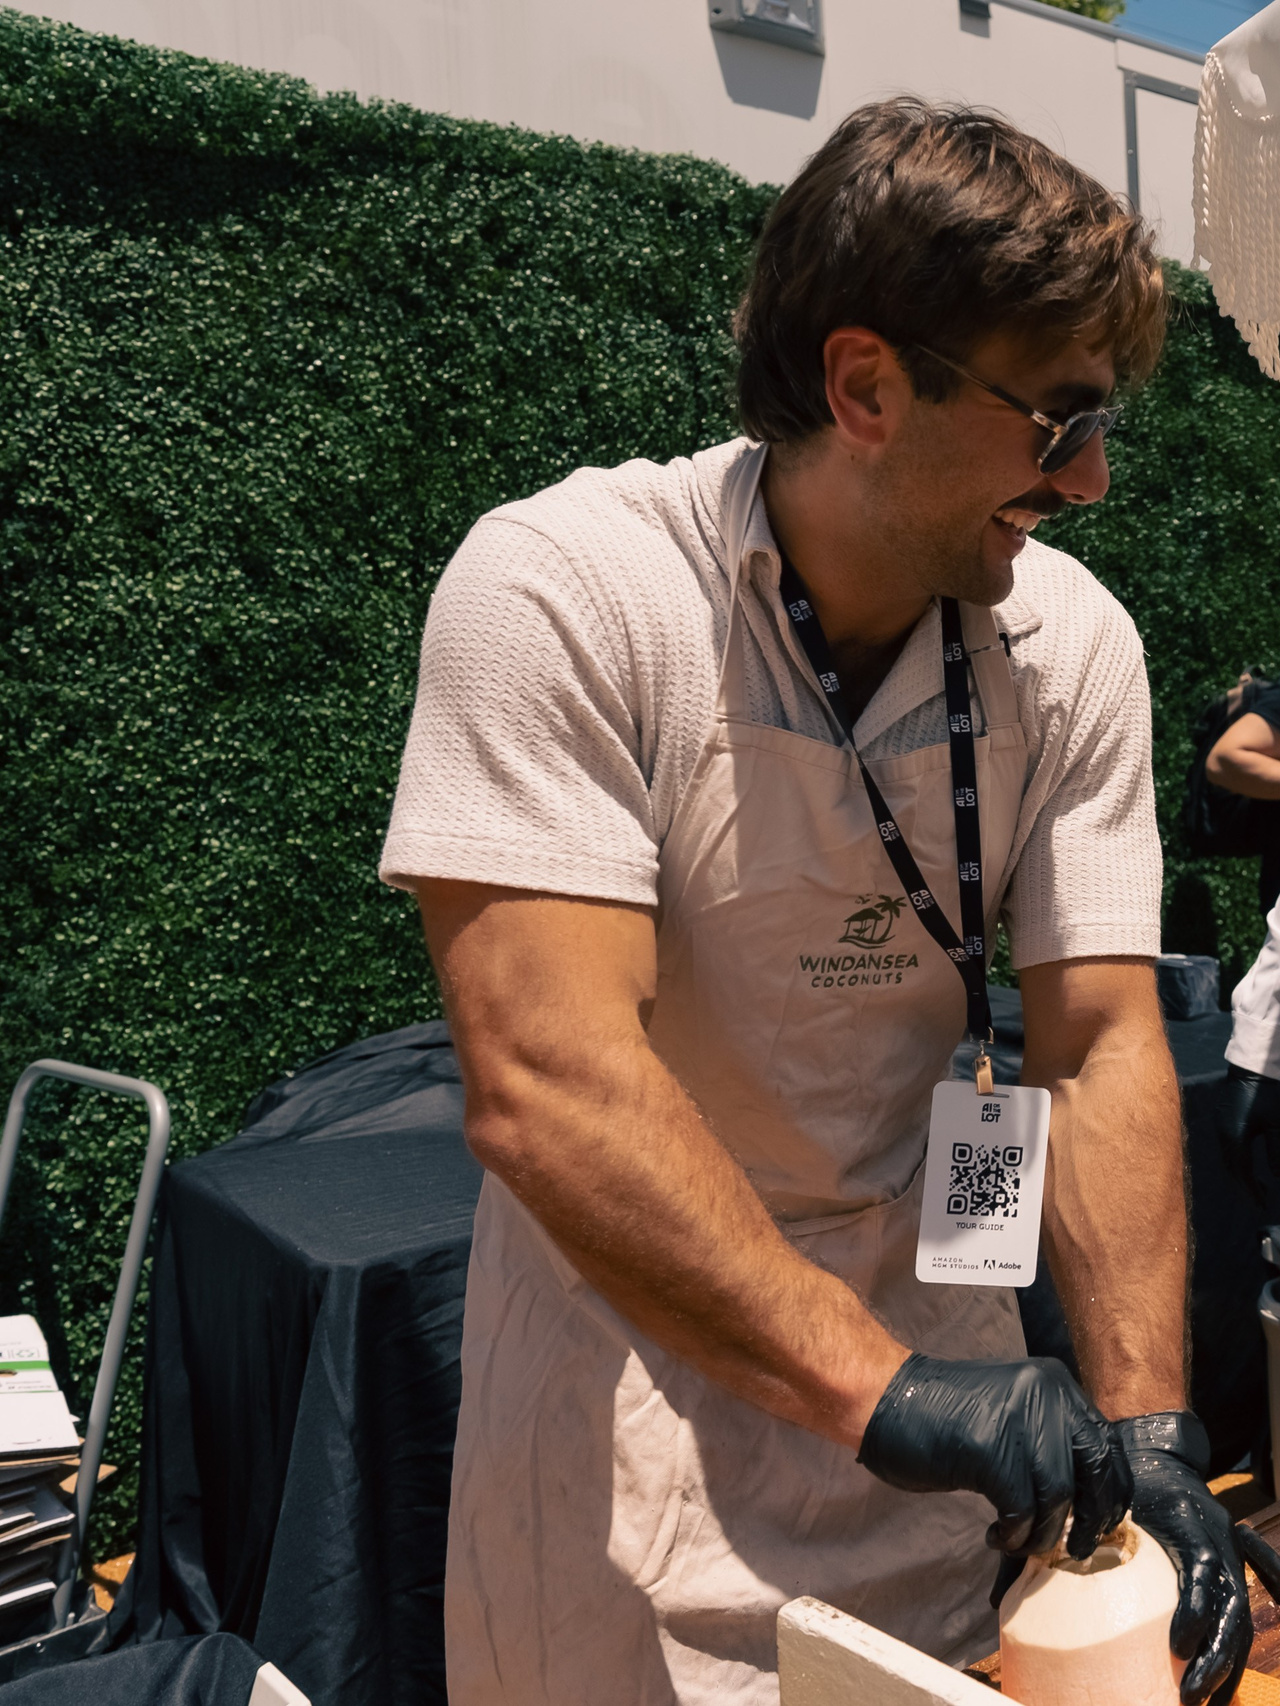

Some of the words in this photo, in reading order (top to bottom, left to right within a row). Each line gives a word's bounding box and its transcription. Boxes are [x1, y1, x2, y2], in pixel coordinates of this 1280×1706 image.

[798, 600, 810, 610] AI
[788, 602, 804, 621] LOT
[945, 652, 952, 661] AI
[953, 642, 962, 660] LOT
[819, 674, 833, 692] LOT
[828, 672, 838, 682] AI
[951, 723, 960, 732] AI
[960, 714, 970, 732] LOT
[956, 797, 965, 806] AI
[965, 787, 975, 806] LOT
[886, 821, 896, 830] AI
[879, 823, 892, 842] LOT
[960, 871, 969, 881] AI
[970, 862, 979, 881] LOT
[919, 889, 930, 899] AI
[910, 892, 926, 910] LOT
[956, 947, 966, 956] AI
[965, 946, 974, 955] AI
[974, 936, 982, 955] LOT
[947, 948, 962, 962] LOT
[799, 954, 919, 974] WINDANSEA
[811, 972, 903, 988] COCONUTS
[982, 1102, 992, 1112] AI
[981, 1112, 1001, 1123] LOT
